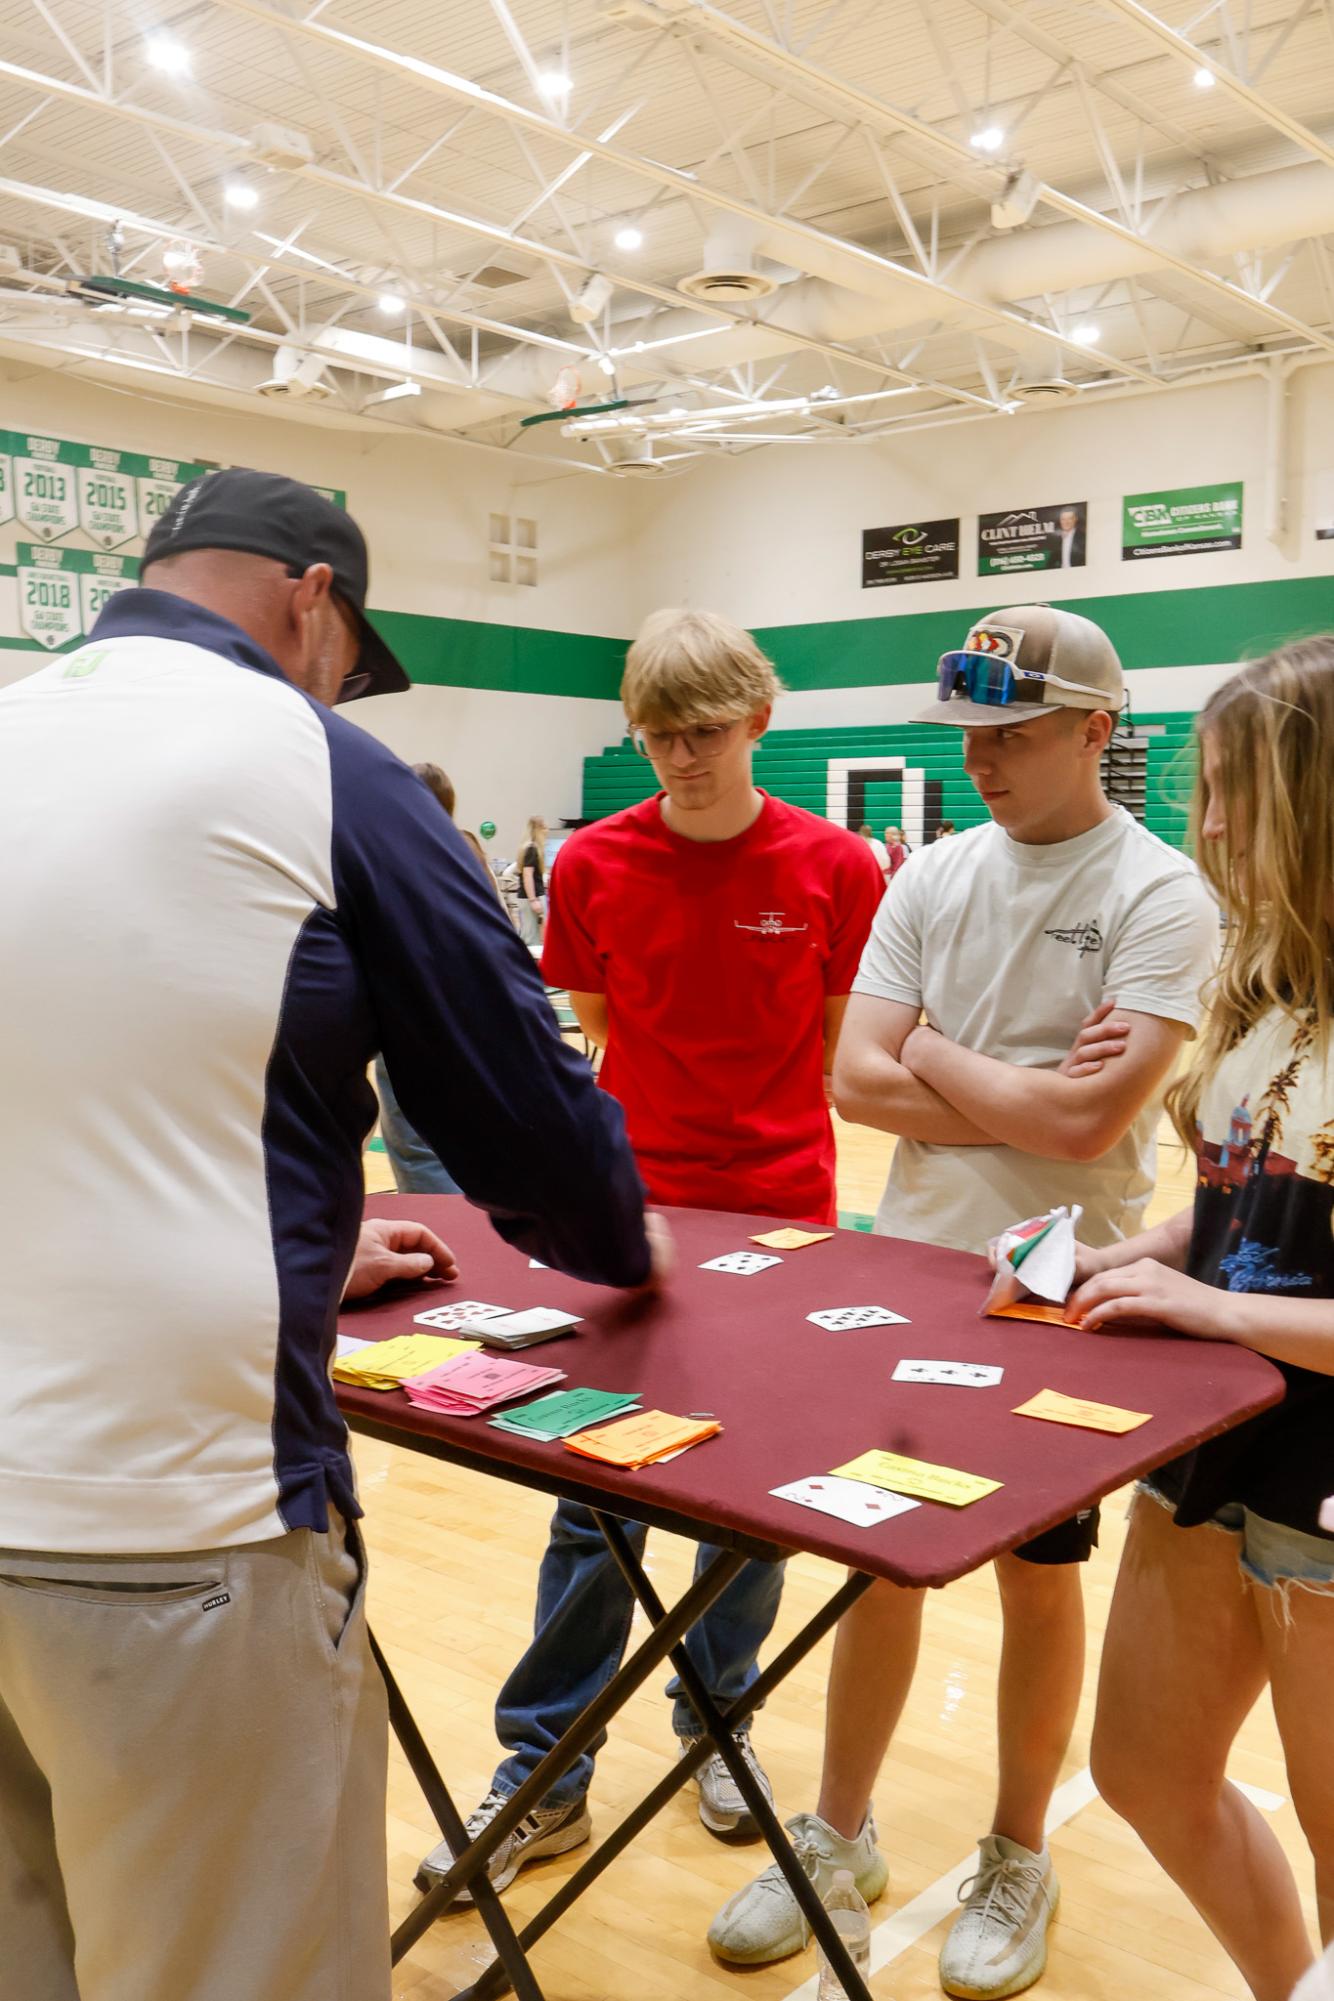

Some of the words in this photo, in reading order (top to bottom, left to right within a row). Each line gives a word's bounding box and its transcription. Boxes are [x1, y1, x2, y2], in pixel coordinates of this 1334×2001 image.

[24, 472, 65, 501] 2013
[86, 482, 126, 511] 2015
[865, 549, 900, 560] DERBY
[901, 546, 923, 556] EYE
[924, 542, 956, 553] CARE
[27, 581, 70, 608] 2018
[203, 1596, 228, 1609] HURLEY
